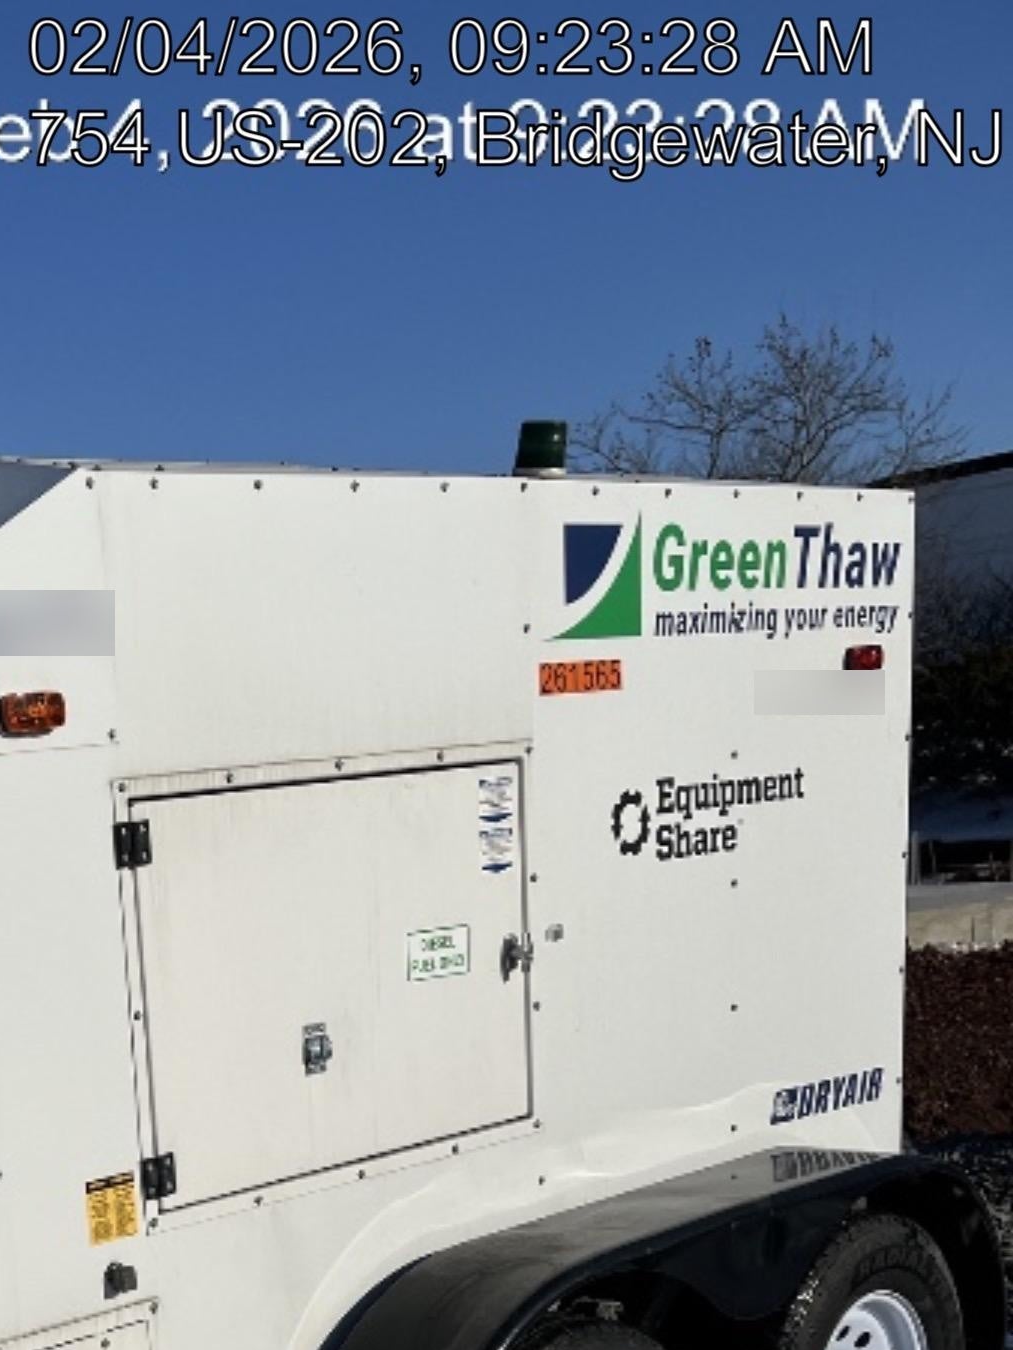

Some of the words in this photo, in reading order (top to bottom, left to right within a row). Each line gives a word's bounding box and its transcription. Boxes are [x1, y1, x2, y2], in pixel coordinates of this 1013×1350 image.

[654, 602, 779, 639] maximizing
[784, 606, 829, 639] your
[833, 602, 900, 635] energy
[540, 659, 622, 694] 261565
[655, 766, 805, 820] Equipment
[655, 822, 738, 861] Share
[796, 1066, 885, 1120] DRYAIR
